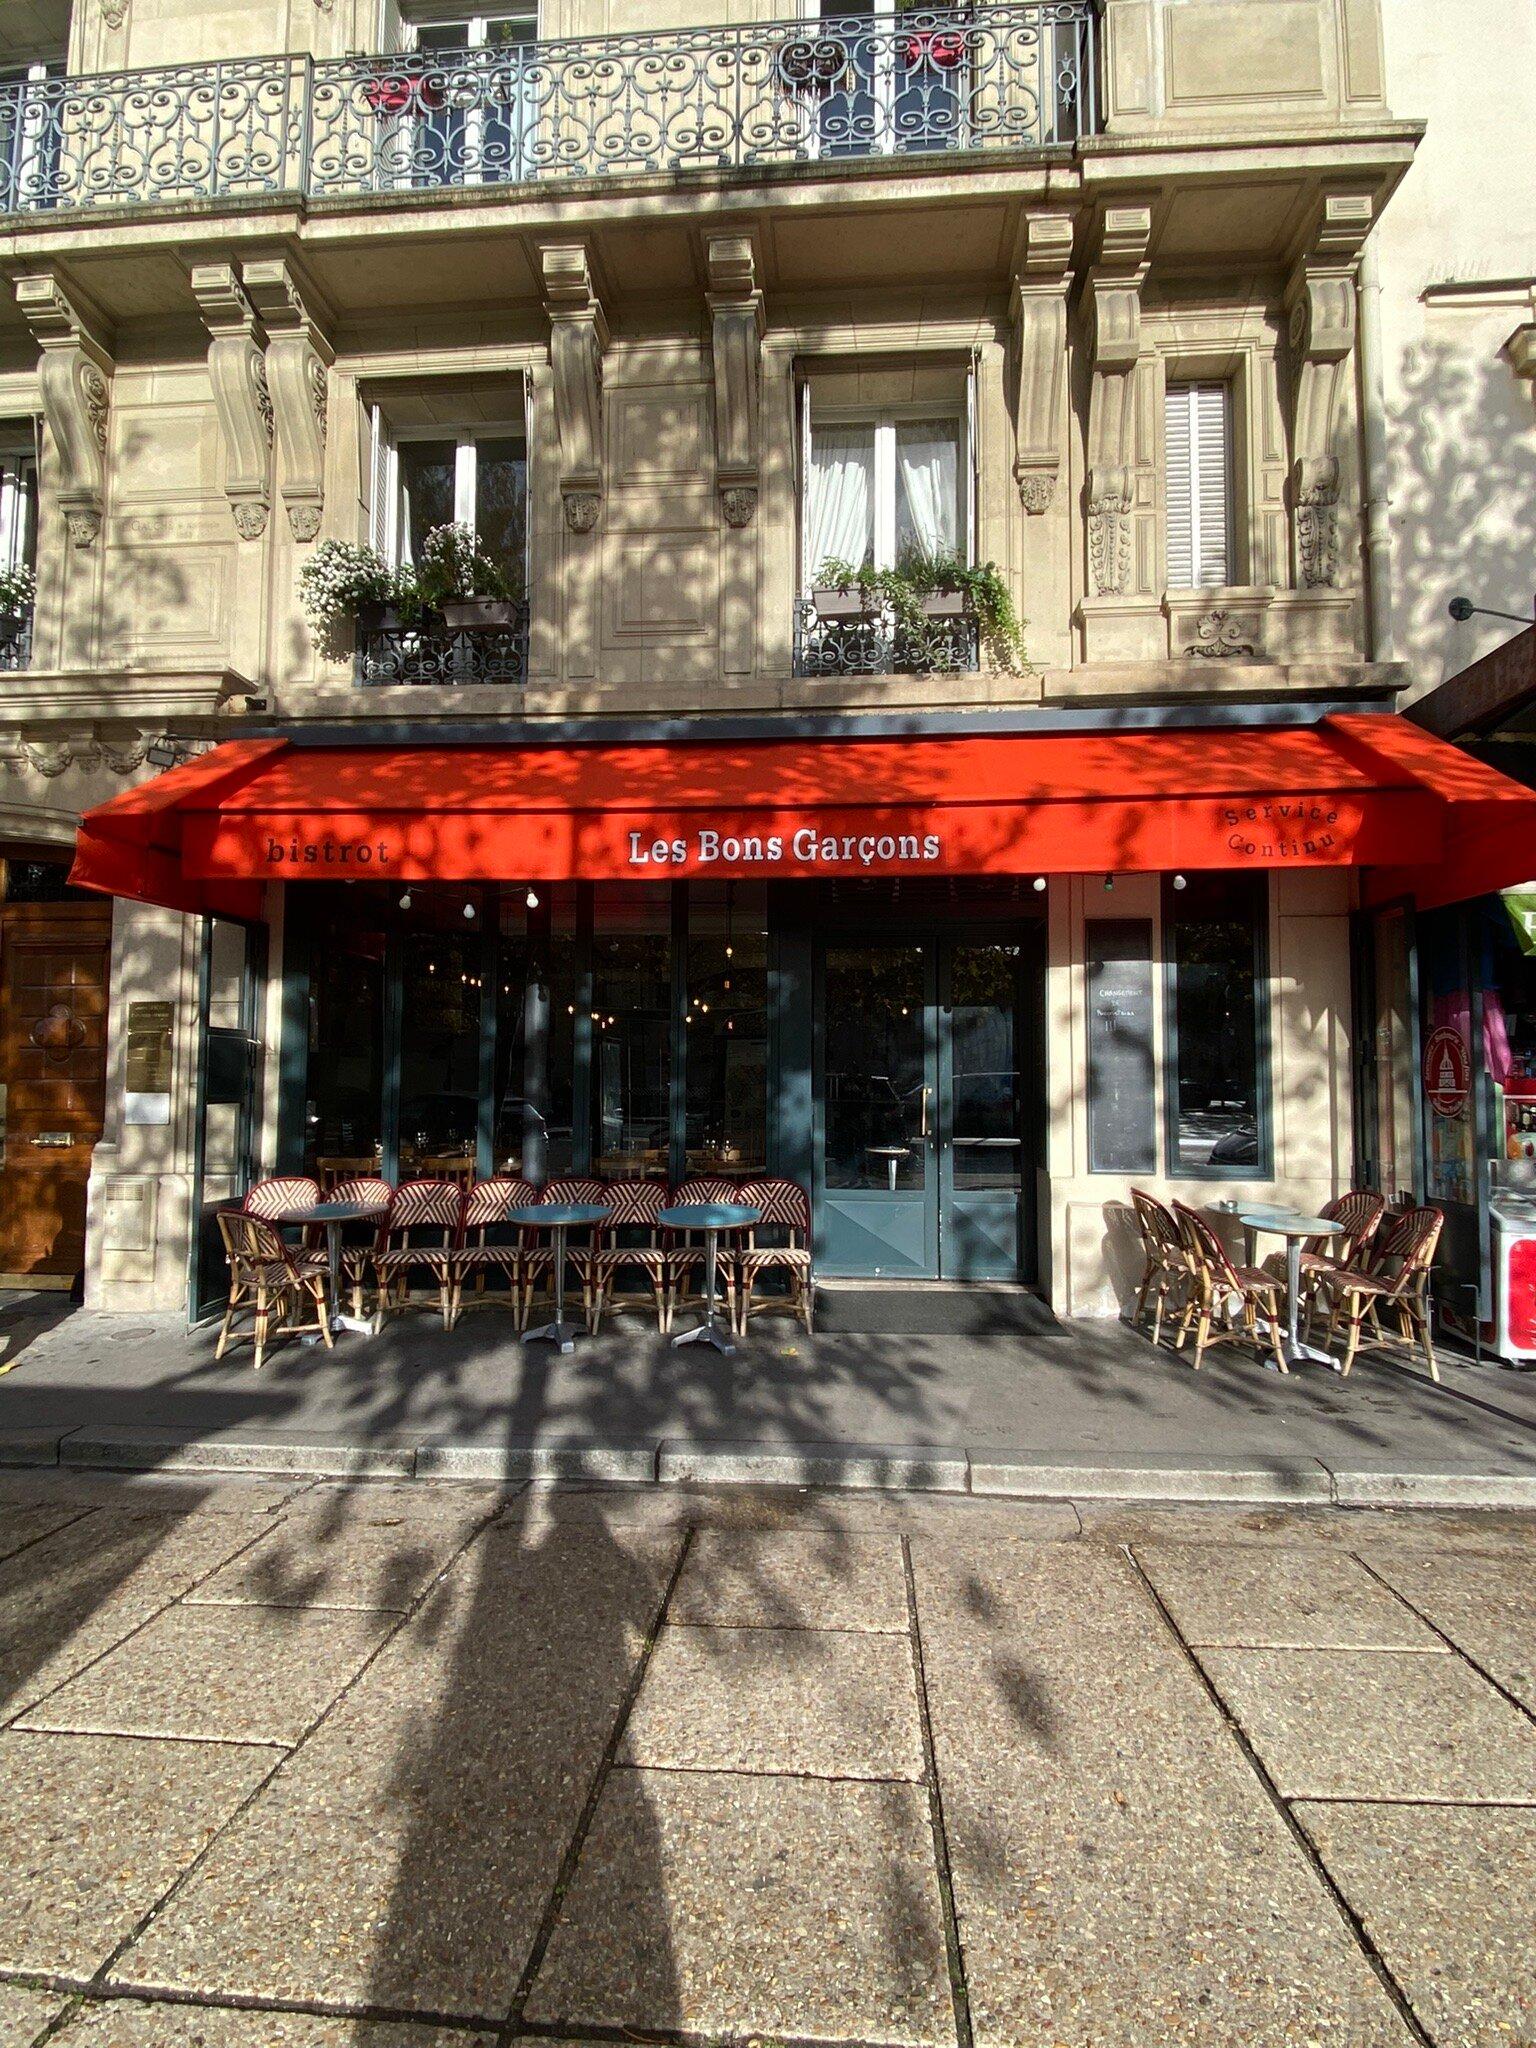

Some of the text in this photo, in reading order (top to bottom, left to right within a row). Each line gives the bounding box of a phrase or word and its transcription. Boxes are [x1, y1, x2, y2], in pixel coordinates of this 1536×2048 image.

[1224, 801, 1338, 827] Service
[266, 838, 389, 863] bistrot
[628, 827, 940, 866] Les Bons Garçons
[1228, 833, 1336, 857] Continu
